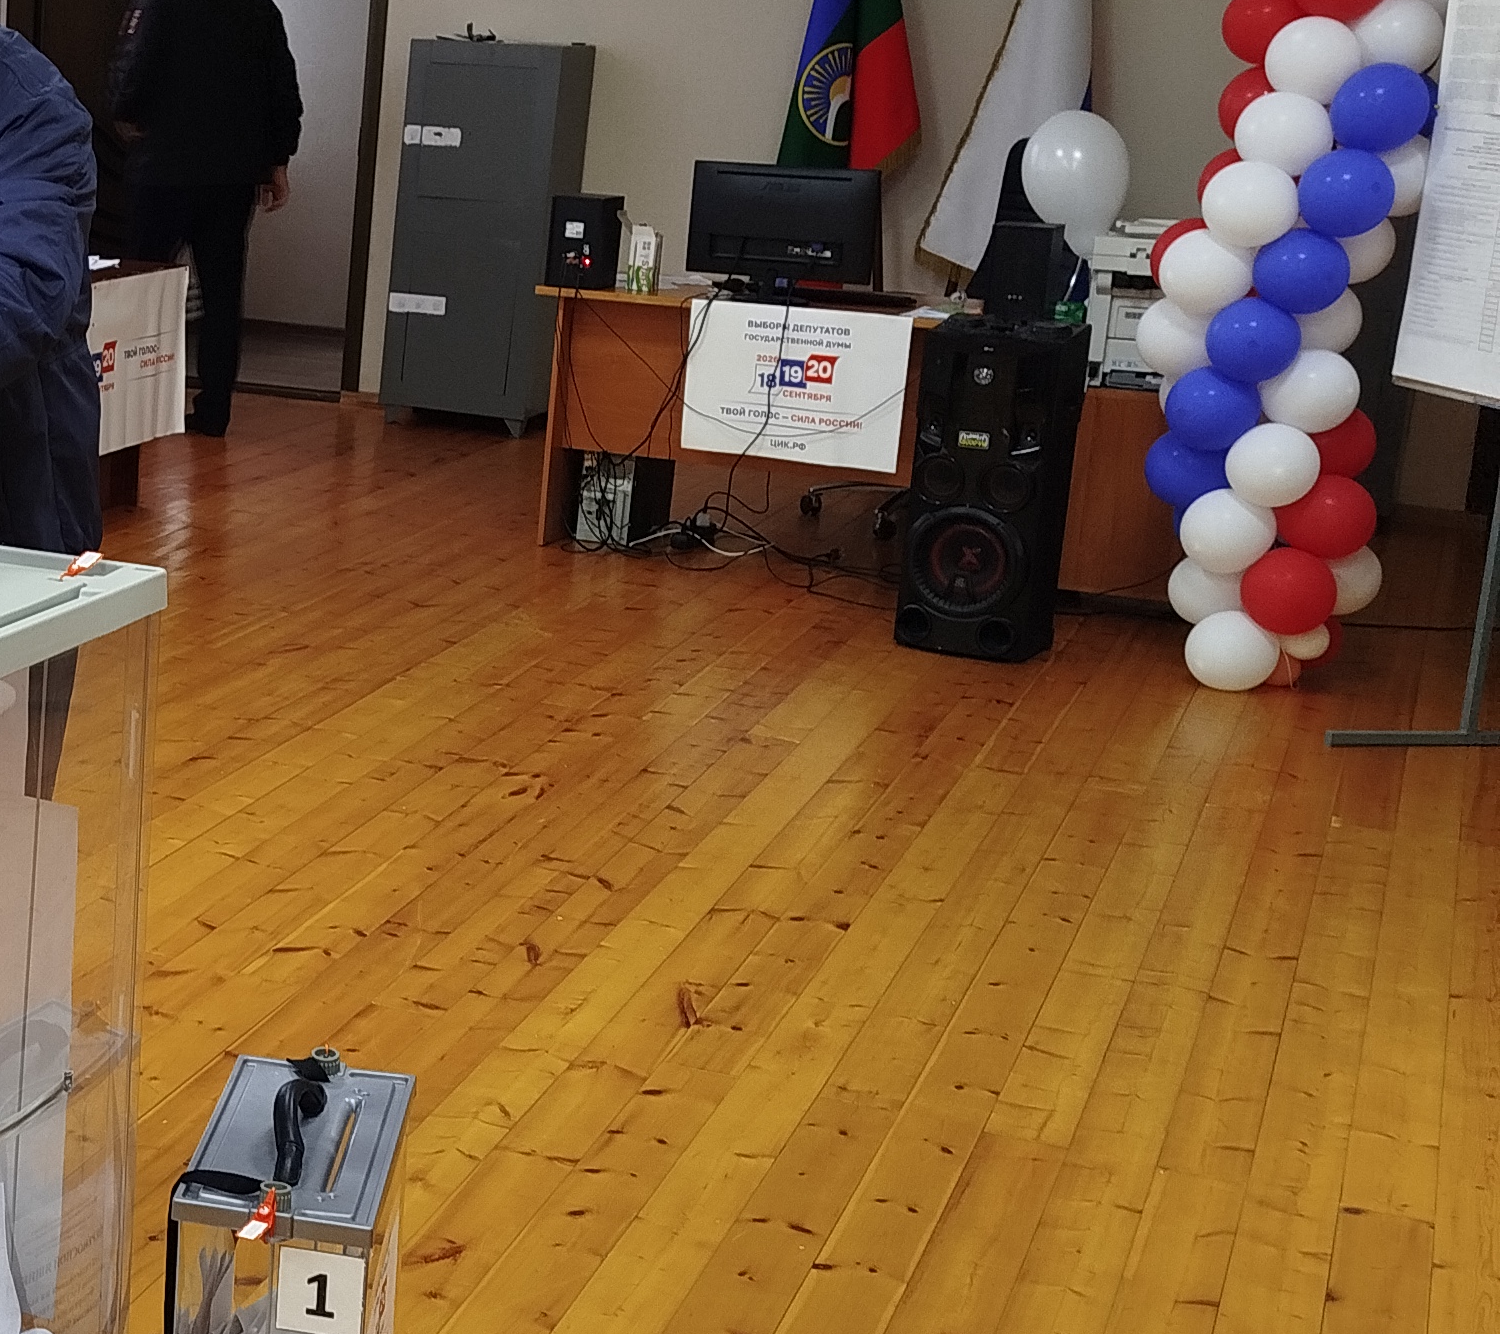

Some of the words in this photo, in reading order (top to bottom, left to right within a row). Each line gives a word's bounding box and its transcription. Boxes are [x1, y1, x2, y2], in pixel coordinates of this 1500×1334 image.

[792, 324, 851, 336] ДЕПУТАТОВ
[826, 340, 852, 349] ДУМЫ
[102, 348, 114, 368] 20
[757, 371, 777, 388] 18
[782, 365, 802, 383] 19
[806, 359, 833, 378] 20
[782, 389, 832, 403] СЕНТЯБРЯ
[720, 406, 746, 417] ТВОЙ
[748, 409, 780, 420] ГОЛОС
[790, 414, 816, 426] СИЛА
[818, 418, 862, 430] РОССИИ!
[770, 439, 806, 451] ЦИК.РФ
[304, 1272, 336, 1319] 1
